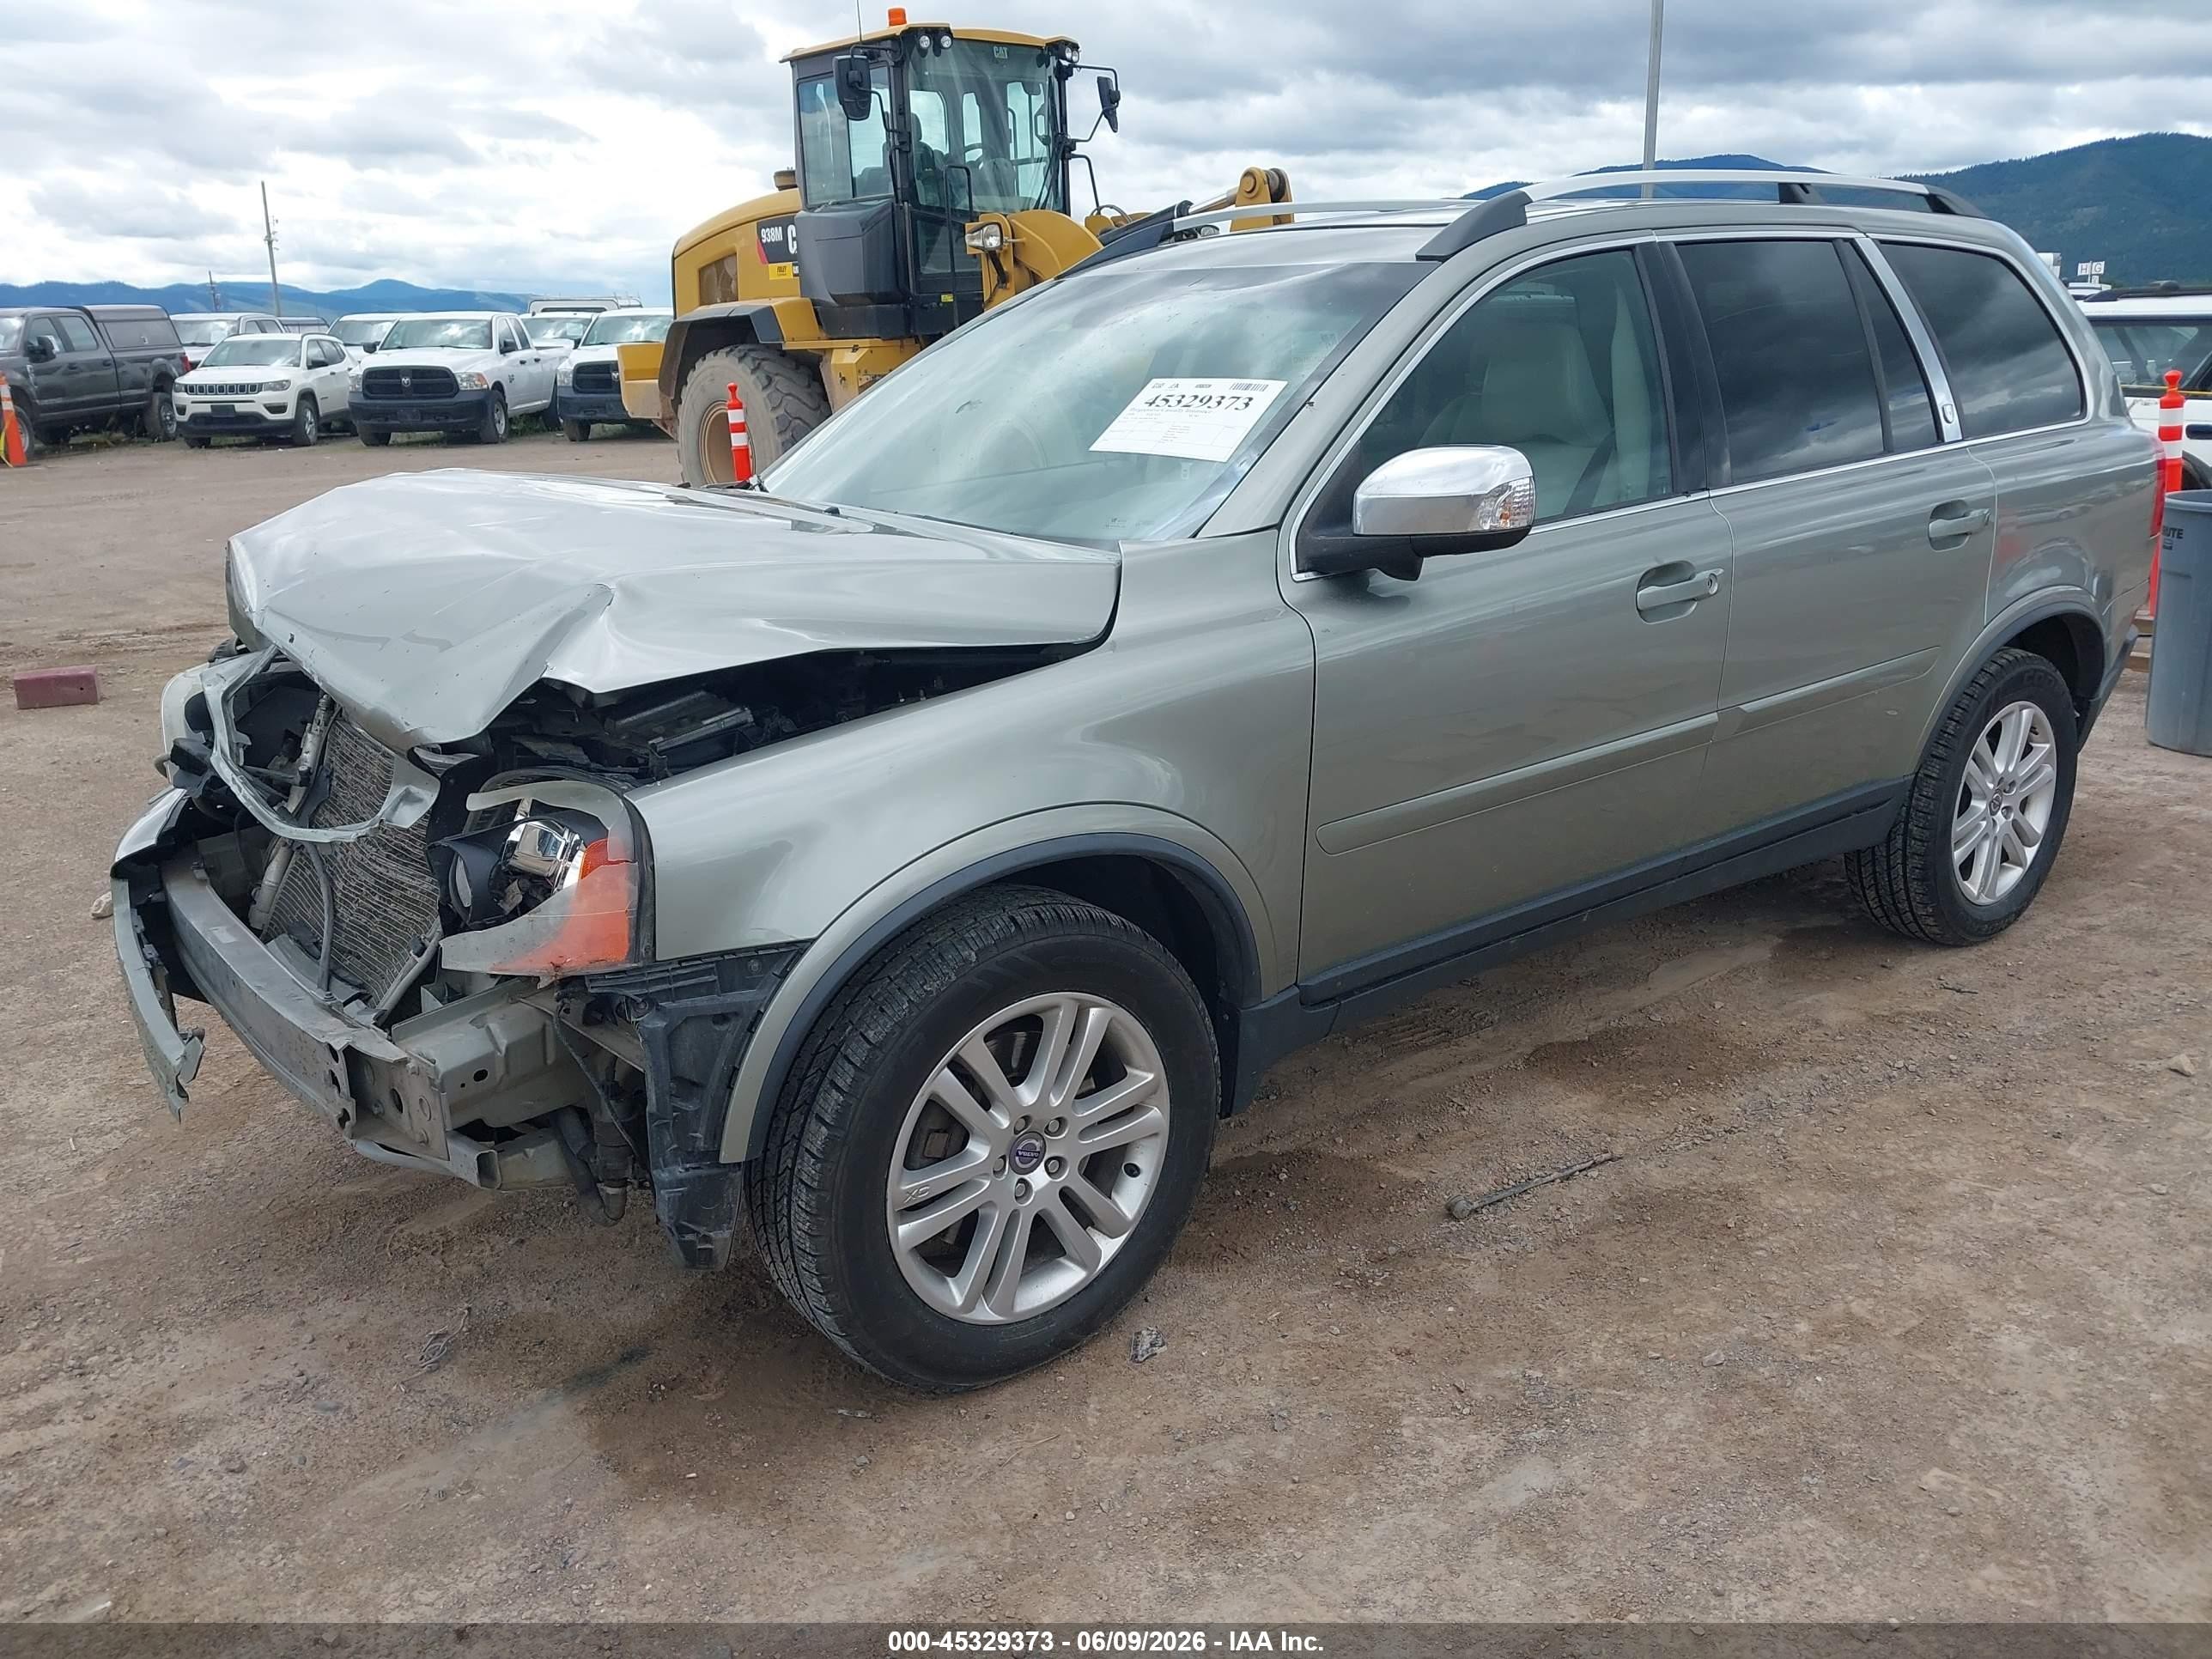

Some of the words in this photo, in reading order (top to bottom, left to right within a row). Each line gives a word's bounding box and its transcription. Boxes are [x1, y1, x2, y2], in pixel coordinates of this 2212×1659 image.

[993, 45, 1008, 59] CAT
[761, 226, 783, 243] 938M
[787, 224, 799, 255] C
[2094, 262, 2102, 273] G
[1144, 393, 1255, 411] 45329373
